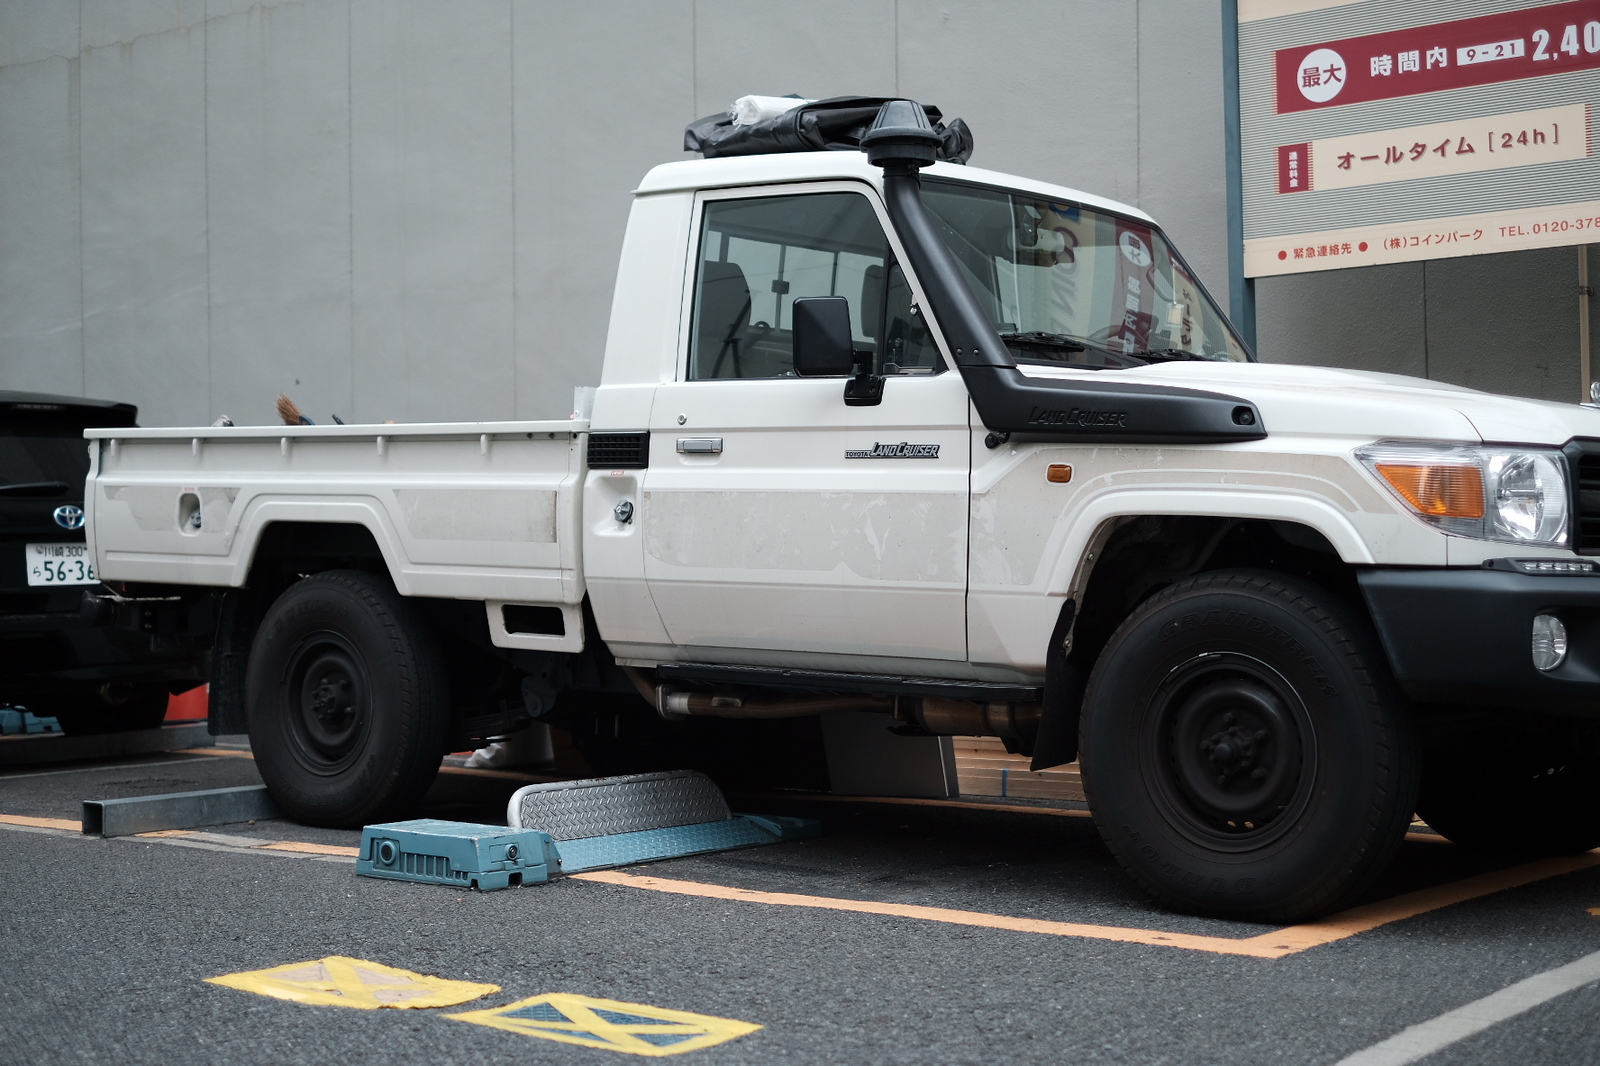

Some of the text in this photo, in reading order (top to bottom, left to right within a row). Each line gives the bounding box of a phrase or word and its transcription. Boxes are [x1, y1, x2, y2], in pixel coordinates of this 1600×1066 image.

[1302, 64, 1342, 88] 最大
[1370, 46, 1448, 77] 時間内
[1466, 42, 1516, 62] 9-21
[1337, 136, 1476, 170] オールタイム
[1293, 242, 1352, 260] 緊急連絡先
[65, 546, 83, 557] 300
[1156, 609, 1338, 698] GRANDTREK
[1121, 824, 1257, 893] DUNLOP
